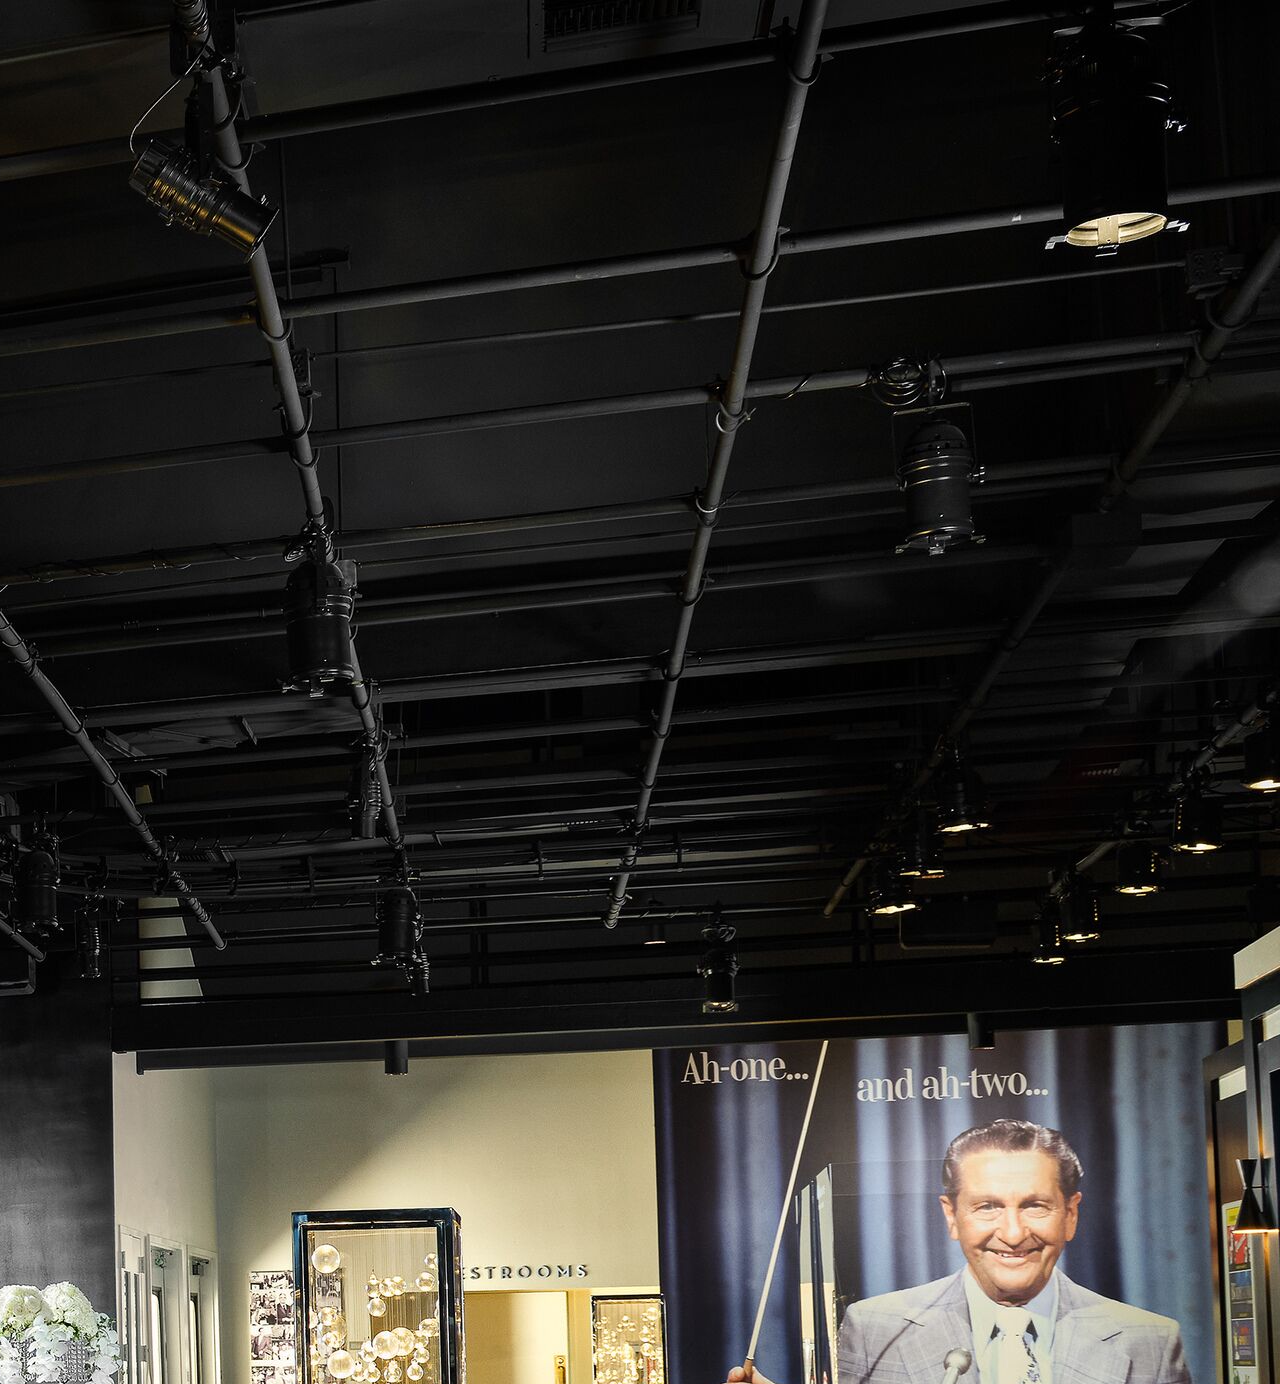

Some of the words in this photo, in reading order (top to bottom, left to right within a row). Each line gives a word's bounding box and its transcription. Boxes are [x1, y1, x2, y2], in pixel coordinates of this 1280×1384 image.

[681, 1052, 808, 1084] Ah-one...
[856, 1068, 915, 1103] and
[922, 1065, 1050, 1101] ah-two...
[462, 1264, 588, 1280] STROOMS
